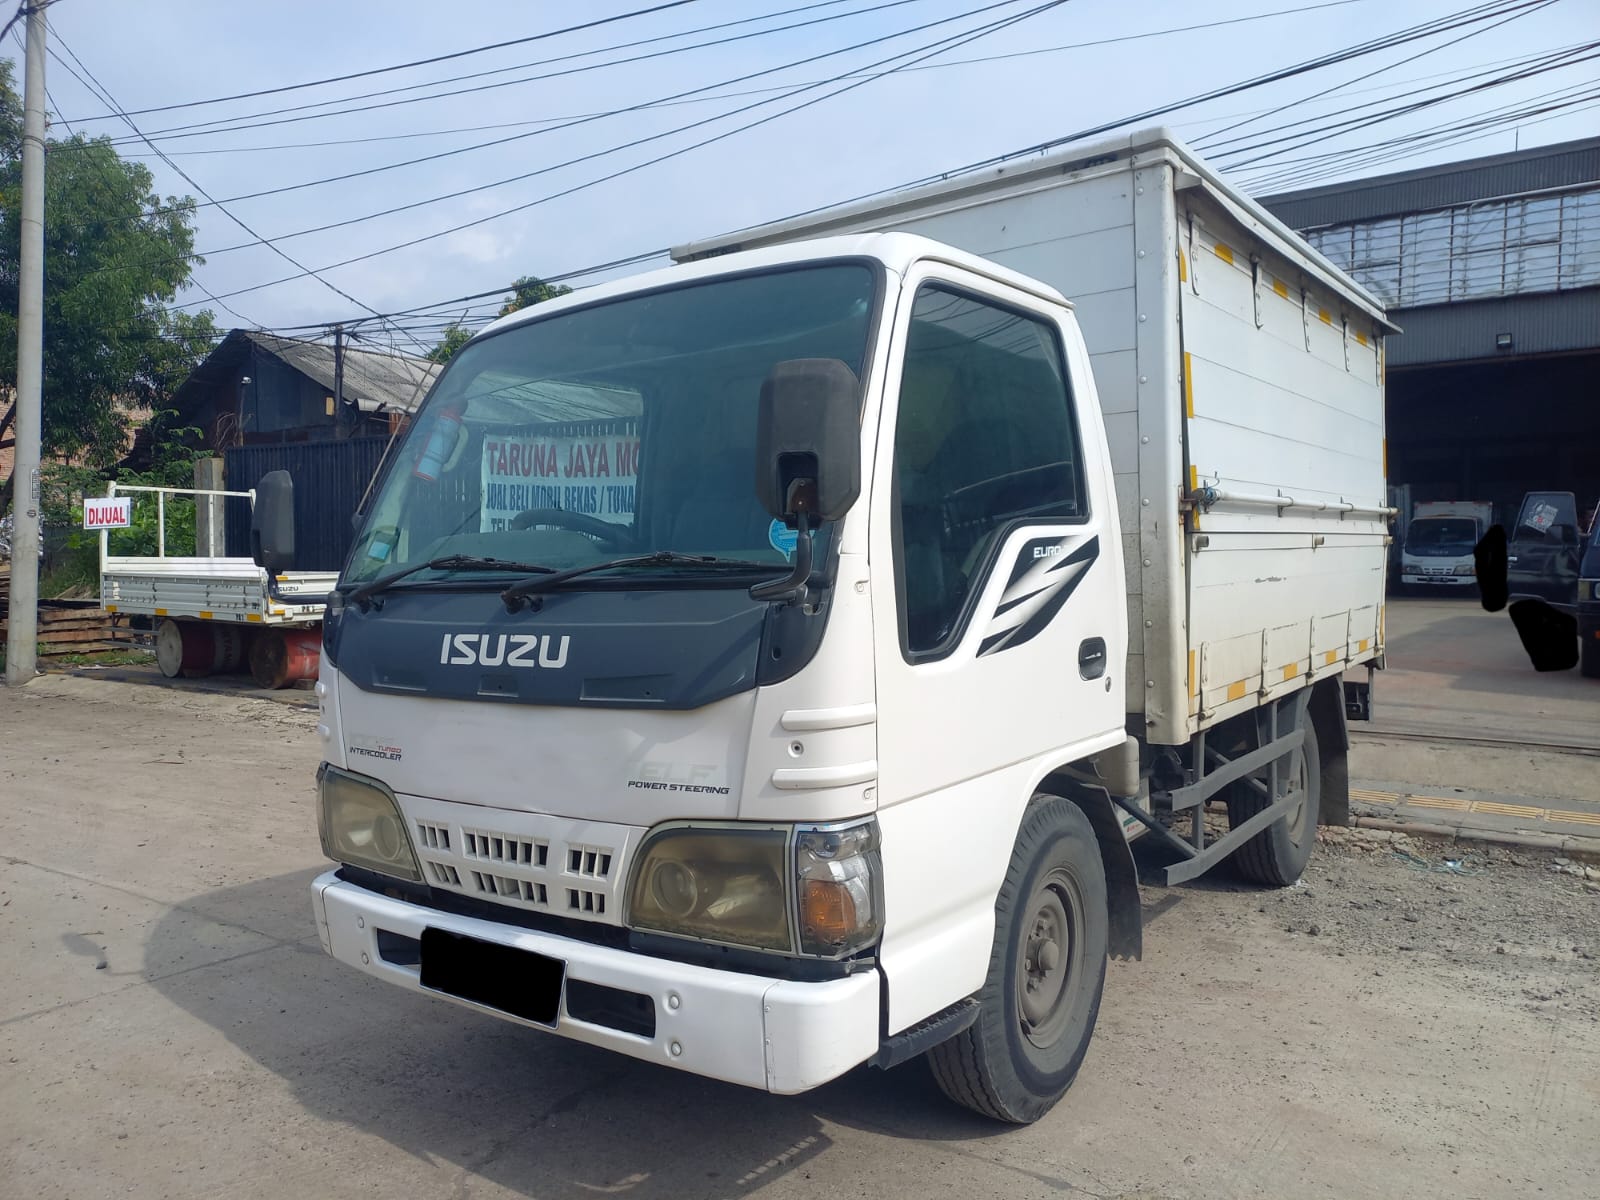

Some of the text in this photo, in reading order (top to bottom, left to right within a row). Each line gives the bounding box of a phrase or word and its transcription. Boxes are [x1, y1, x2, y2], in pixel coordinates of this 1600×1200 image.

[487, 443, 558, 477] TARUNA
[564, 444, 610, 478] JAYA
[486, 483, 507, 510] JUAL
[509, 484, 529, 511] BELI
[531, 485, 561, 511] MOBIL
[564, 486, 597, 514] BEKAS
[88, 506, 126, 525] DIJUAL
[1033, 546, 1061, 558] EURO
[278, 585, 299, 594] SUZU
[440, 633, 571, 669] ISUZU
[349, 746, 402, 761] INTERCOOLER
[377, 744, 402, 753] TURBO
[627, 780, 731, 795] POWER STEERING
